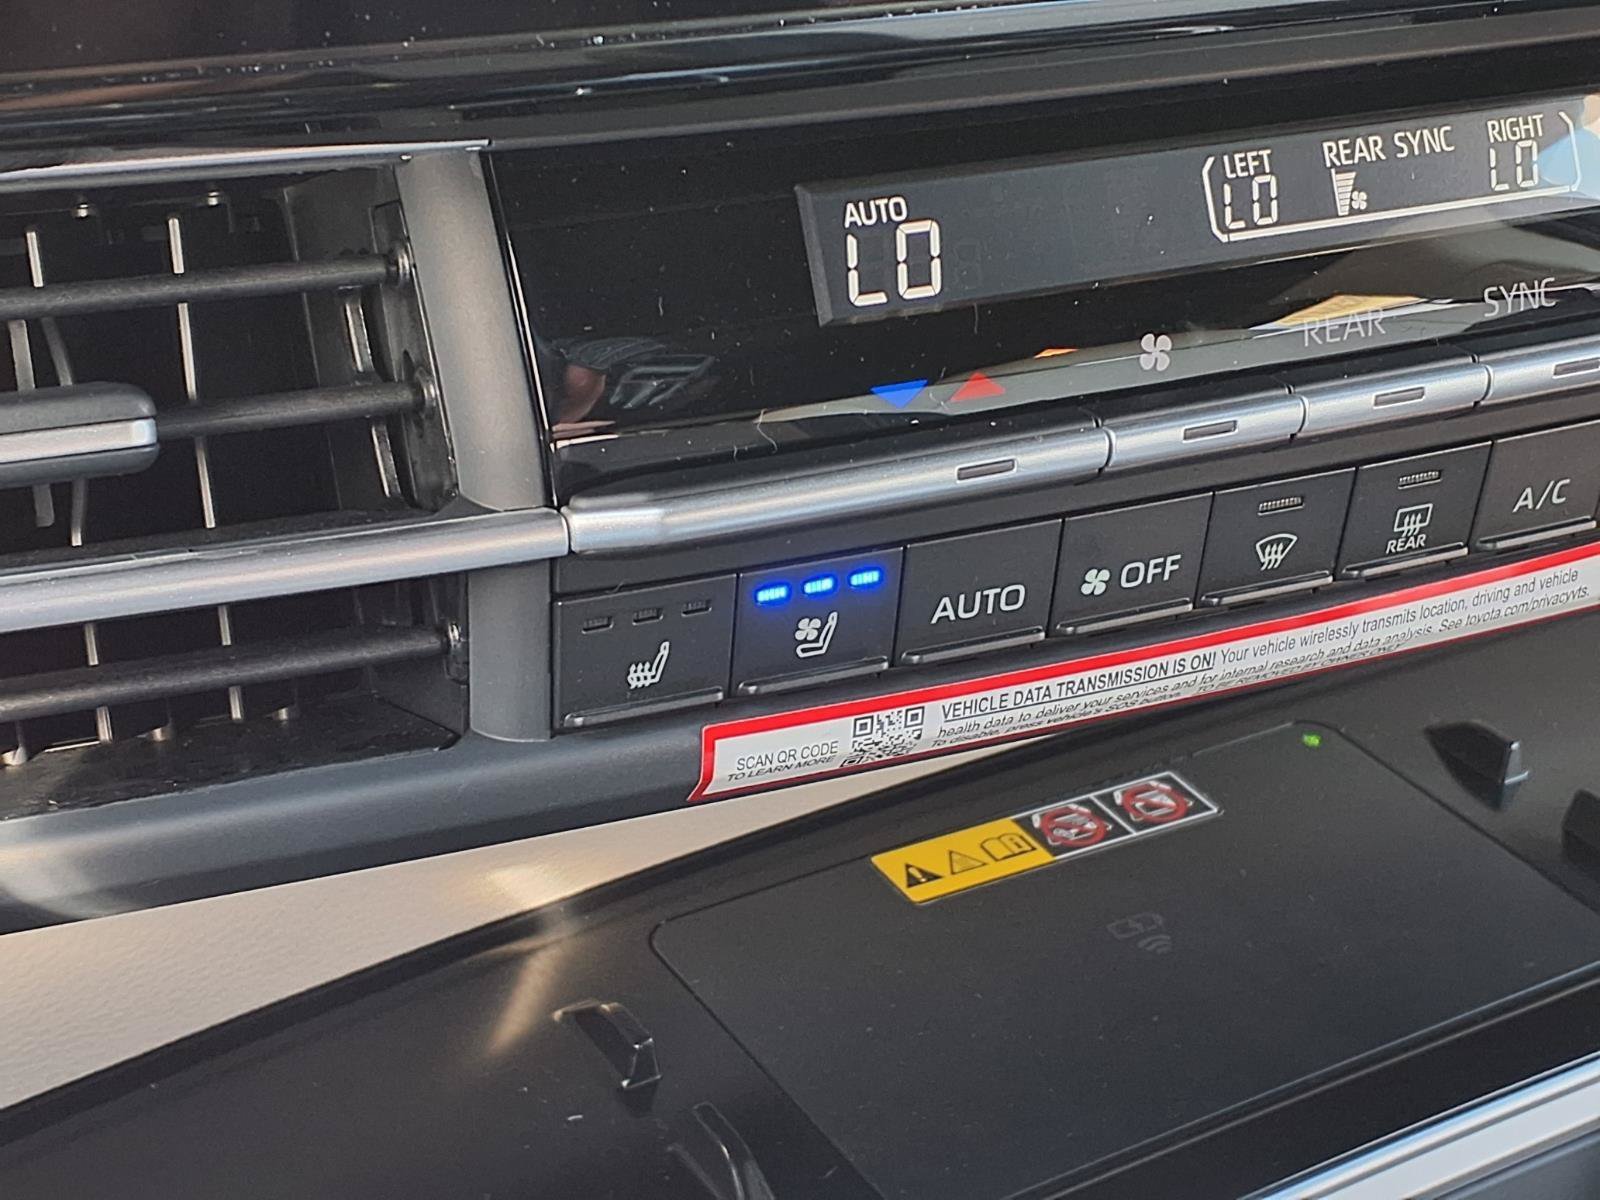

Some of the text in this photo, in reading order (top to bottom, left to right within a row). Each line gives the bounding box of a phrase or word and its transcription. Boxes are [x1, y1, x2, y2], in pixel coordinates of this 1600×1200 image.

[1322, 126, 1456, 168] REAR SYNC
[1486, 113, 1543, 143] RIGHT
[1223, 149, 1272, 179] LEFT
[1489, 140, 1538, 191] LO
[844, 196, 908, 228] AUTO
[1223, 174, 1278, 229] LO
[846, 220, 942, 307] LO
[1483, 277, 1558, 317] SYNC
[1303, 308, 1387, 347] REAR
[1512, 478, 1571, 513] A/C
[1386, 533, 1426, 554] REAR
[1120, 554, 1181, 588] OFF
[930, 584, 1026, 624] AUTO
[942, 693, 1009, 719] VEHICLE
[1014, 685, 1052, 706] DATA
[1057, 661, 1169, 696] TRANSMISSION
[1173, 658, 1187, 674] IS
[1190, 651, 1217, 670] ON!
[1221, 645, 1249, 664] Your
[1252, 637, 1296, 657] vehicle
[1300, 622, 1359, 648] wirelessly
[1362, 609, 1416, 633] transmits
[1472, 586, 1510, 607] driving
[1514, 577, 1535, 597] and
[1539, 568, 1579, 590] vehicle
[937, 721, 980, 738] health
[984, 714, 1014, 730] data
[1018, 711, 1032, 723] to
[1036, 700, 1081, 718] deliver
[1083, 695, 1113, 711] your
[1115, 685, 1169, 703] services
[1172, 675, 1197, 692] and
[1200, 670, 1218, 685] for
[1221, 661, 1268, 680] internal
[1271, 650, 1325, 670] research
[1327, 643, 1351, 657] and
[1353, 637, 1380, 652] data
[1439, 618, 1464, 633] See
[727, 756, 836, 782] TO LEARN MORE
[736, 740, 839, 771] SCAN QR CODE
